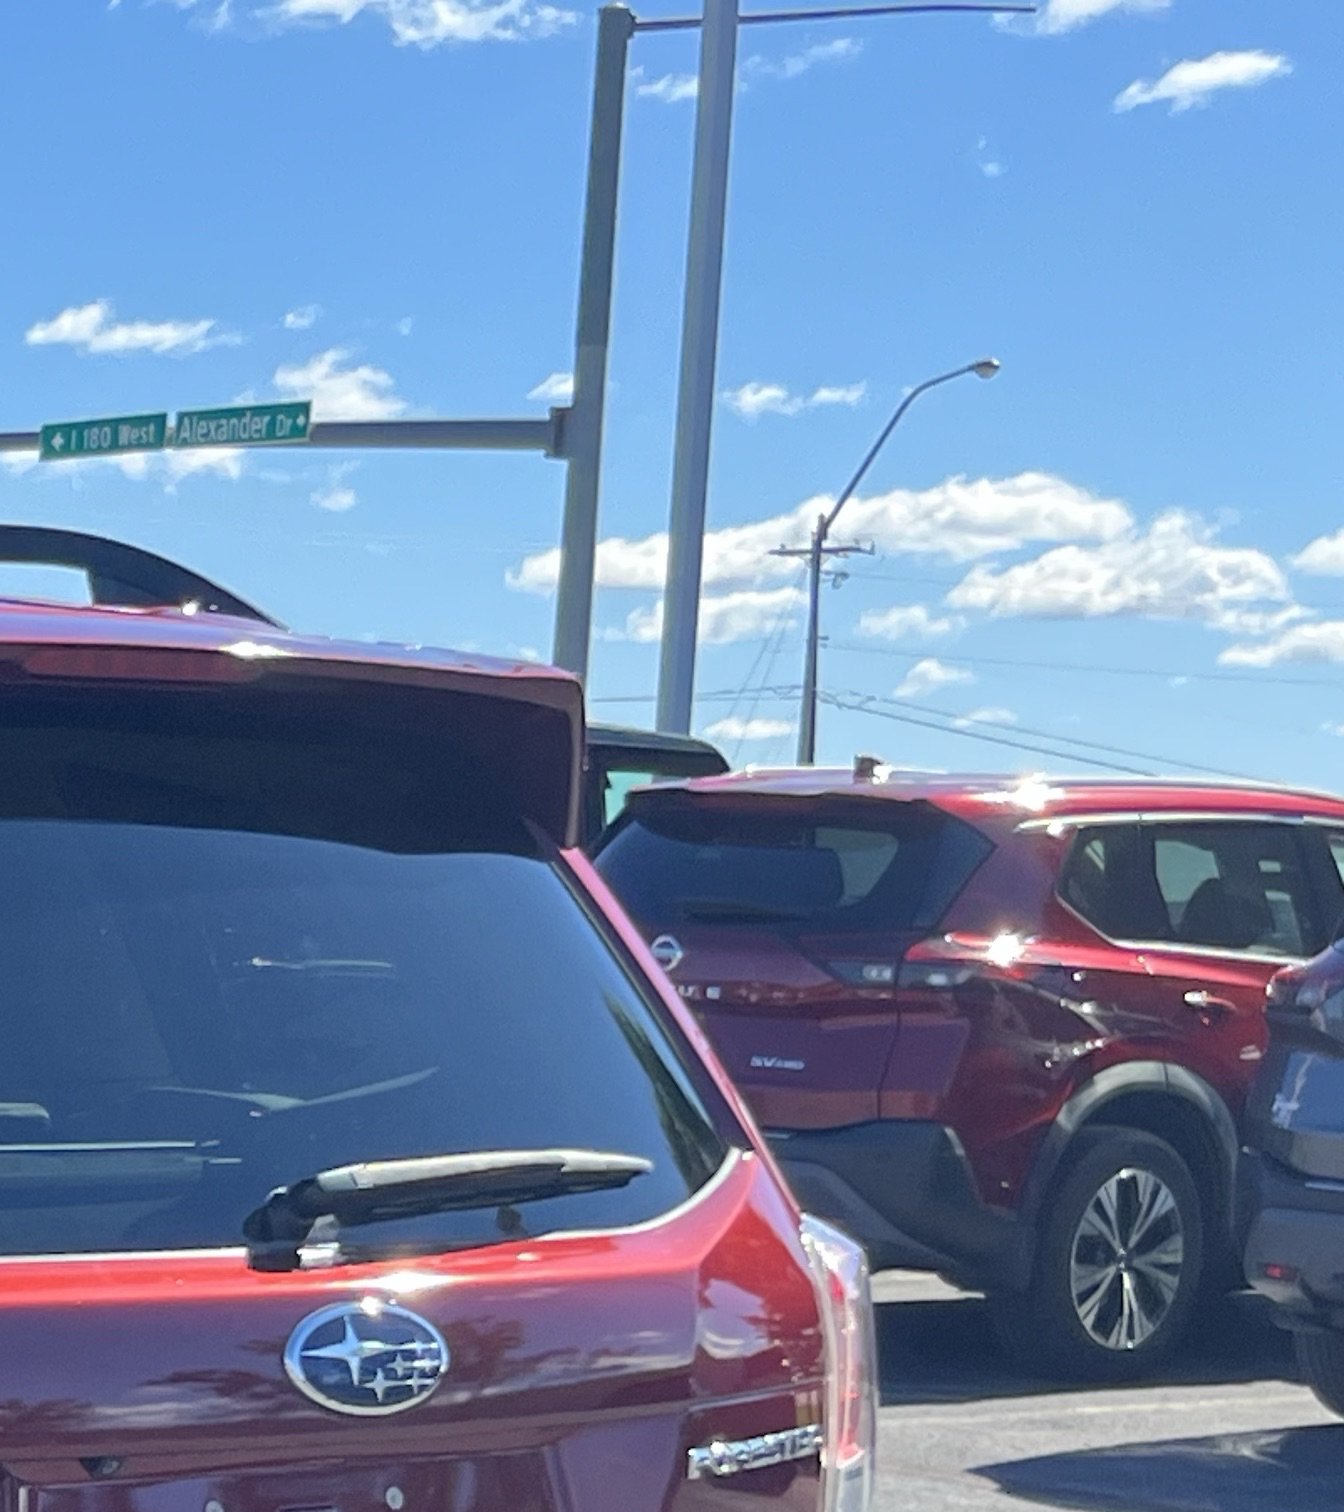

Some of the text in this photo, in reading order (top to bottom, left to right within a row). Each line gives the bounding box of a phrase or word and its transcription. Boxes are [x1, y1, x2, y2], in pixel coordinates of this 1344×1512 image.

[82, 426, 111, 450] 180
[118, 422, 155, 446] West
[177, 409, 293, 443] Alexander Dr
